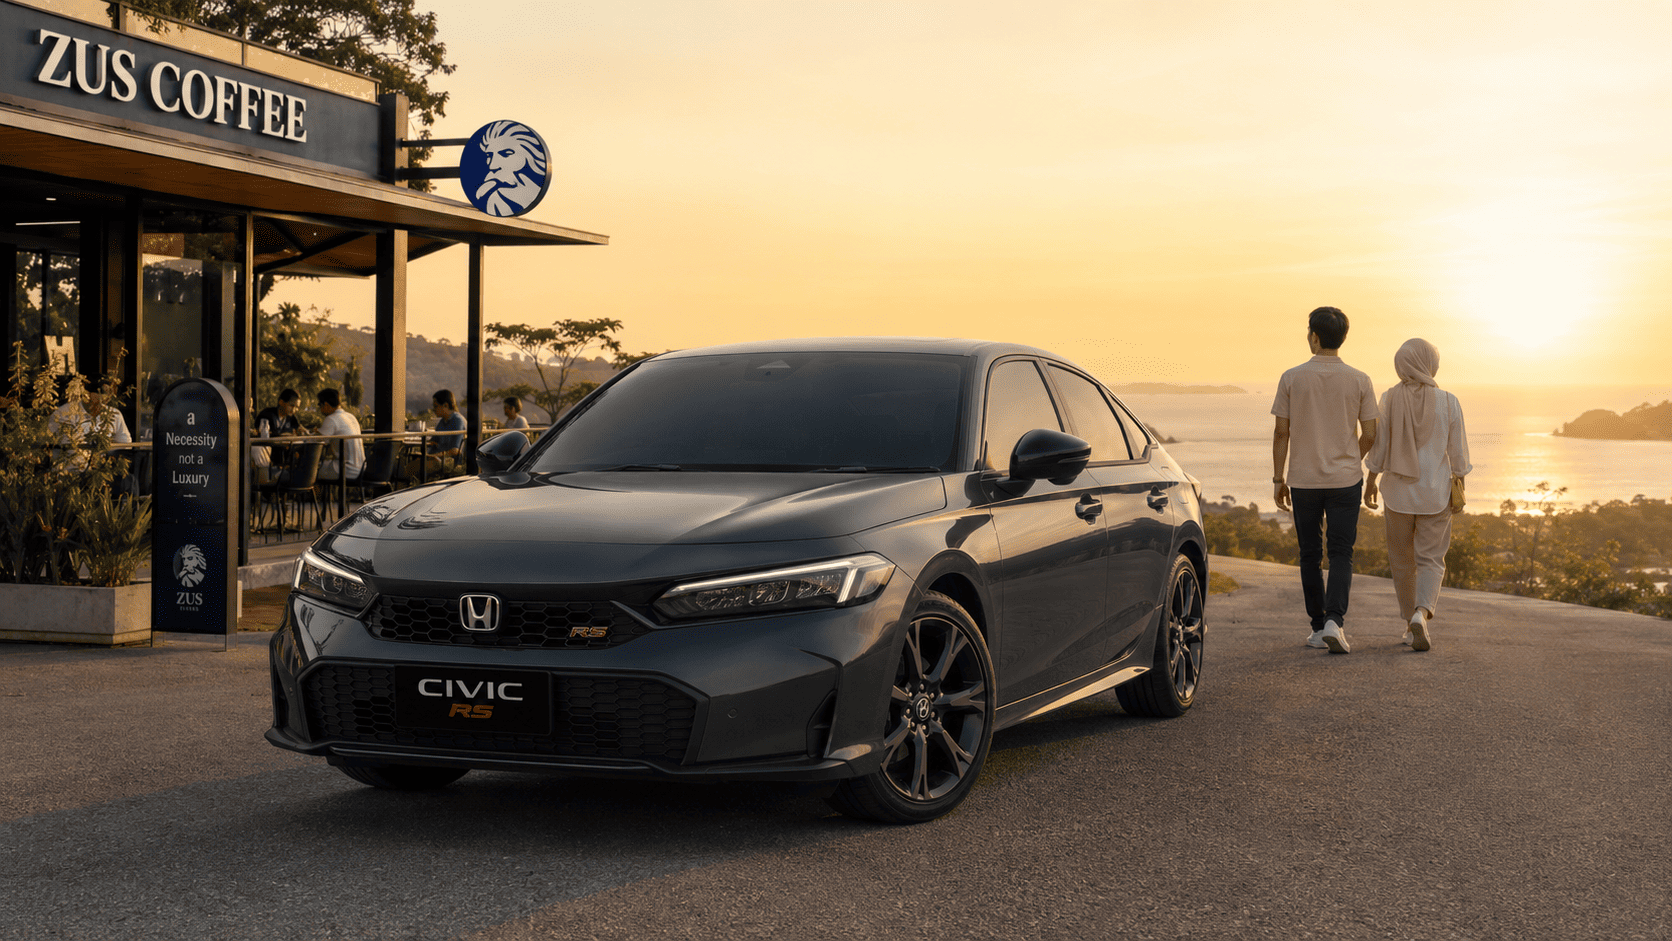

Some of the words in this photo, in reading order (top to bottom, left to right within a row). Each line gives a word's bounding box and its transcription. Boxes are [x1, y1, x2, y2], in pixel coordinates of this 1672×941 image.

[37, 28, 137, 102] ZUS
[150, 61, 307, 143] COFFEE
[186, 412, 195, 426] a
[166, 432, 217, 449] Necessity
[178, 454, 195, 465] not
[197, 455, 204, 465] a
[172, 470, 210, 488] Luxury
[176, 592, 203, 606] ZUS
[569, 626, 608, 638] RS
[417, 678, 523, 701] CIVIC
[448, 703, 494, 719] RS
